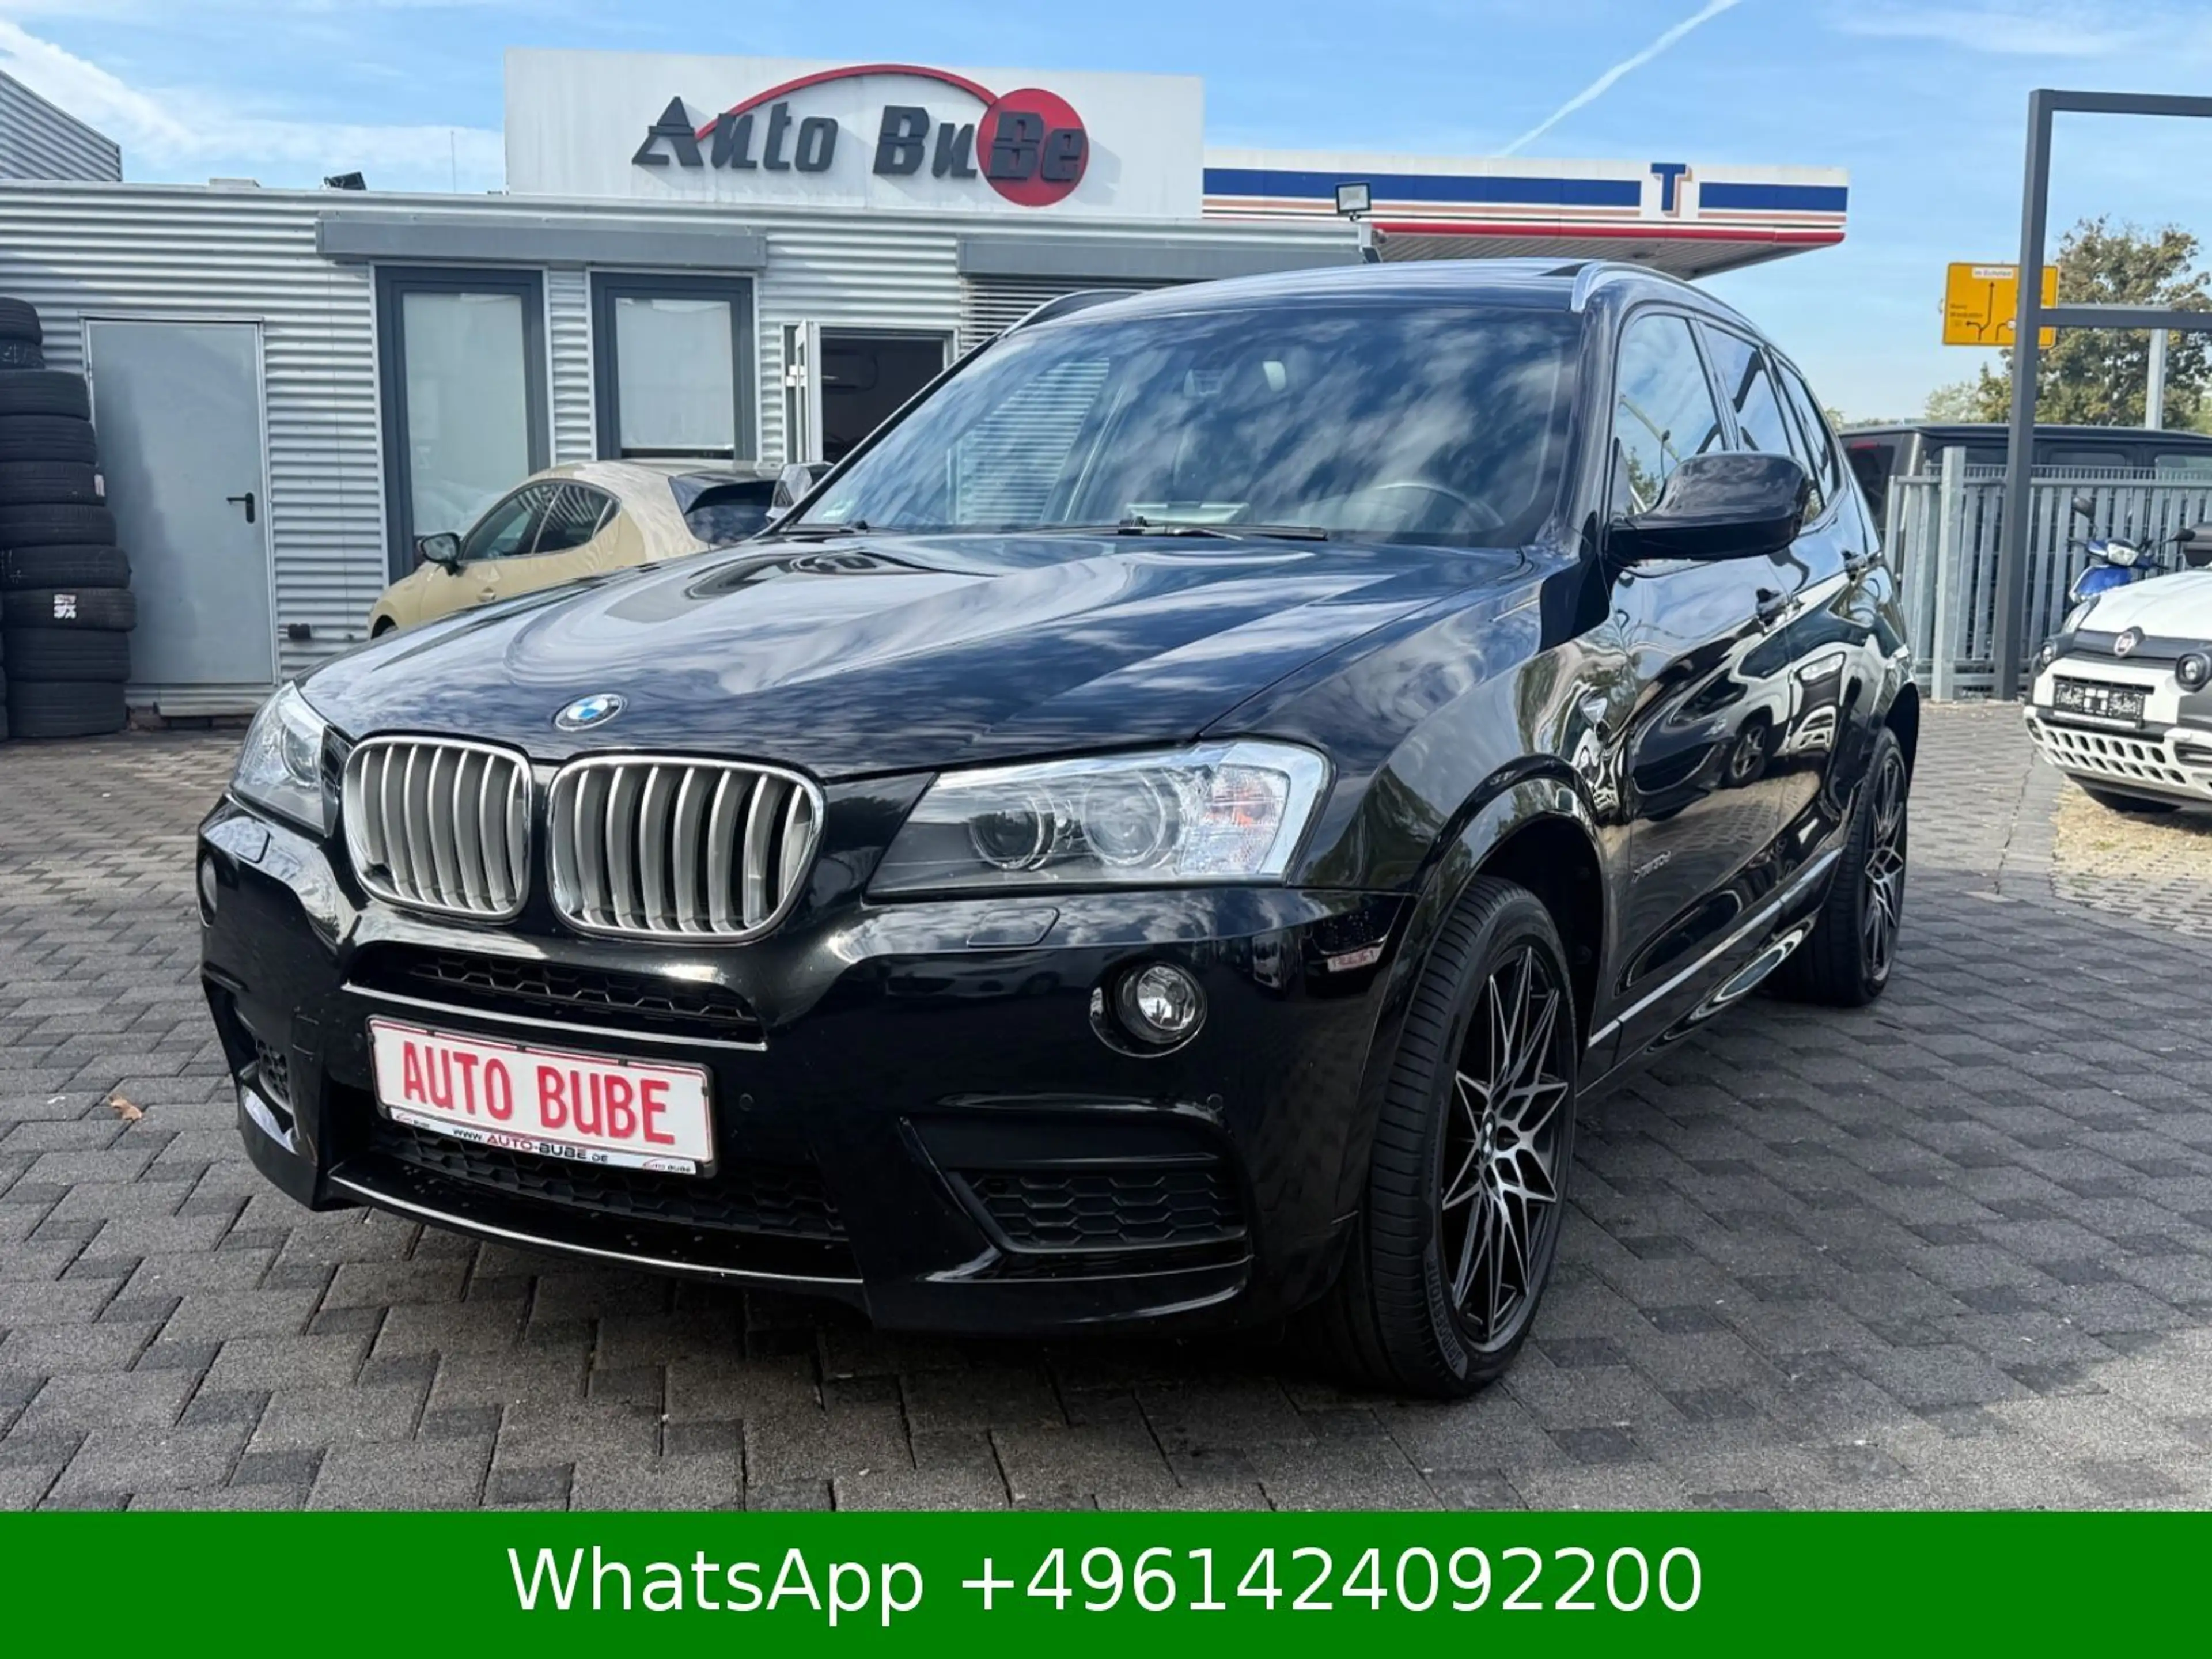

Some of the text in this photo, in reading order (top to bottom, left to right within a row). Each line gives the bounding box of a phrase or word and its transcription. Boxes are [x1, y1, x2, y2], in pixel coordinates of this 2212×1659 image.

[631, 96, 839, 171] Auto
[1650, 163, 1687, 211] T
[403, 1041, 675, 1145] AUTO BUBE
